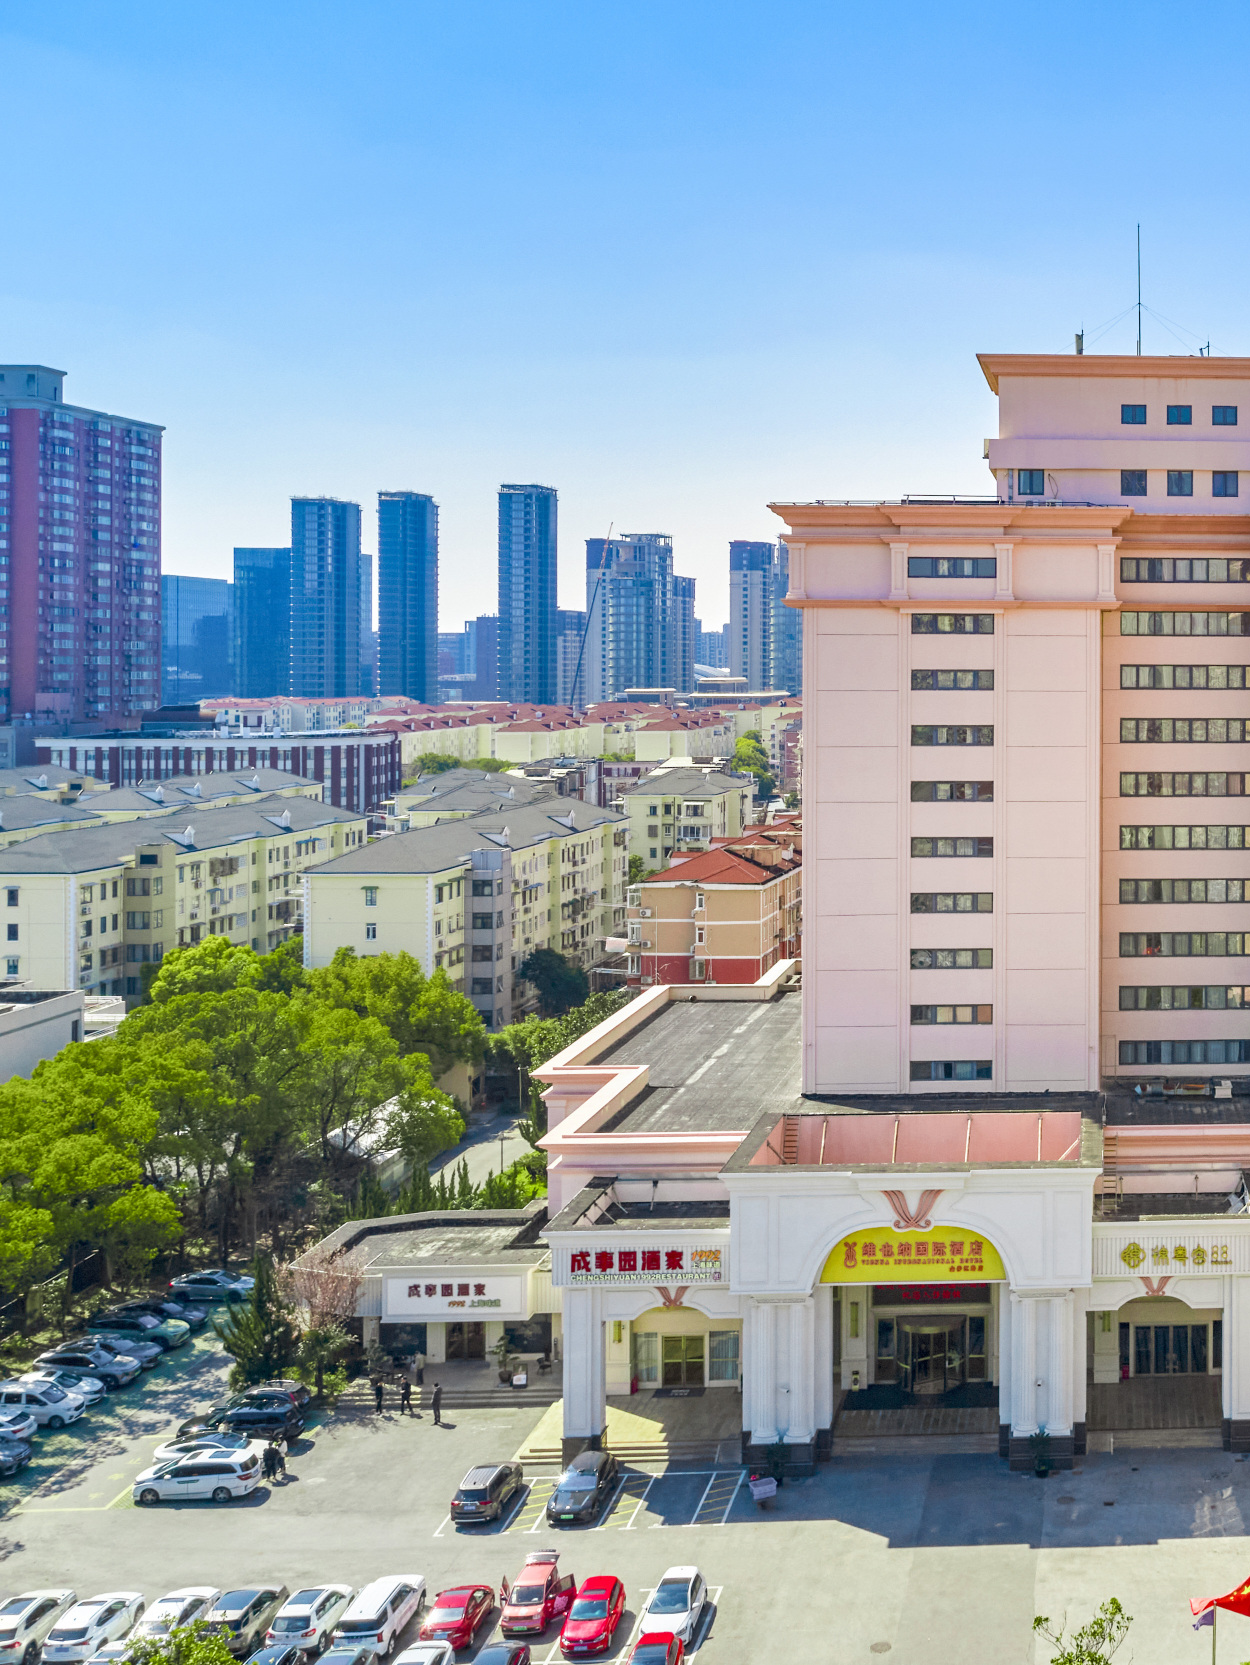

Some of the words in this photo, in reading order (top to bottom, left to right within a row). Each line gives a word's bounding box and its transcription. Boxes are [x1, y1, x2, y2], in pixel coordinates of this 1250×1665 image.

[862, 1240, 983, 1257] 维也纳国际酒店
[691, 1250, 721, 1262] 1992
